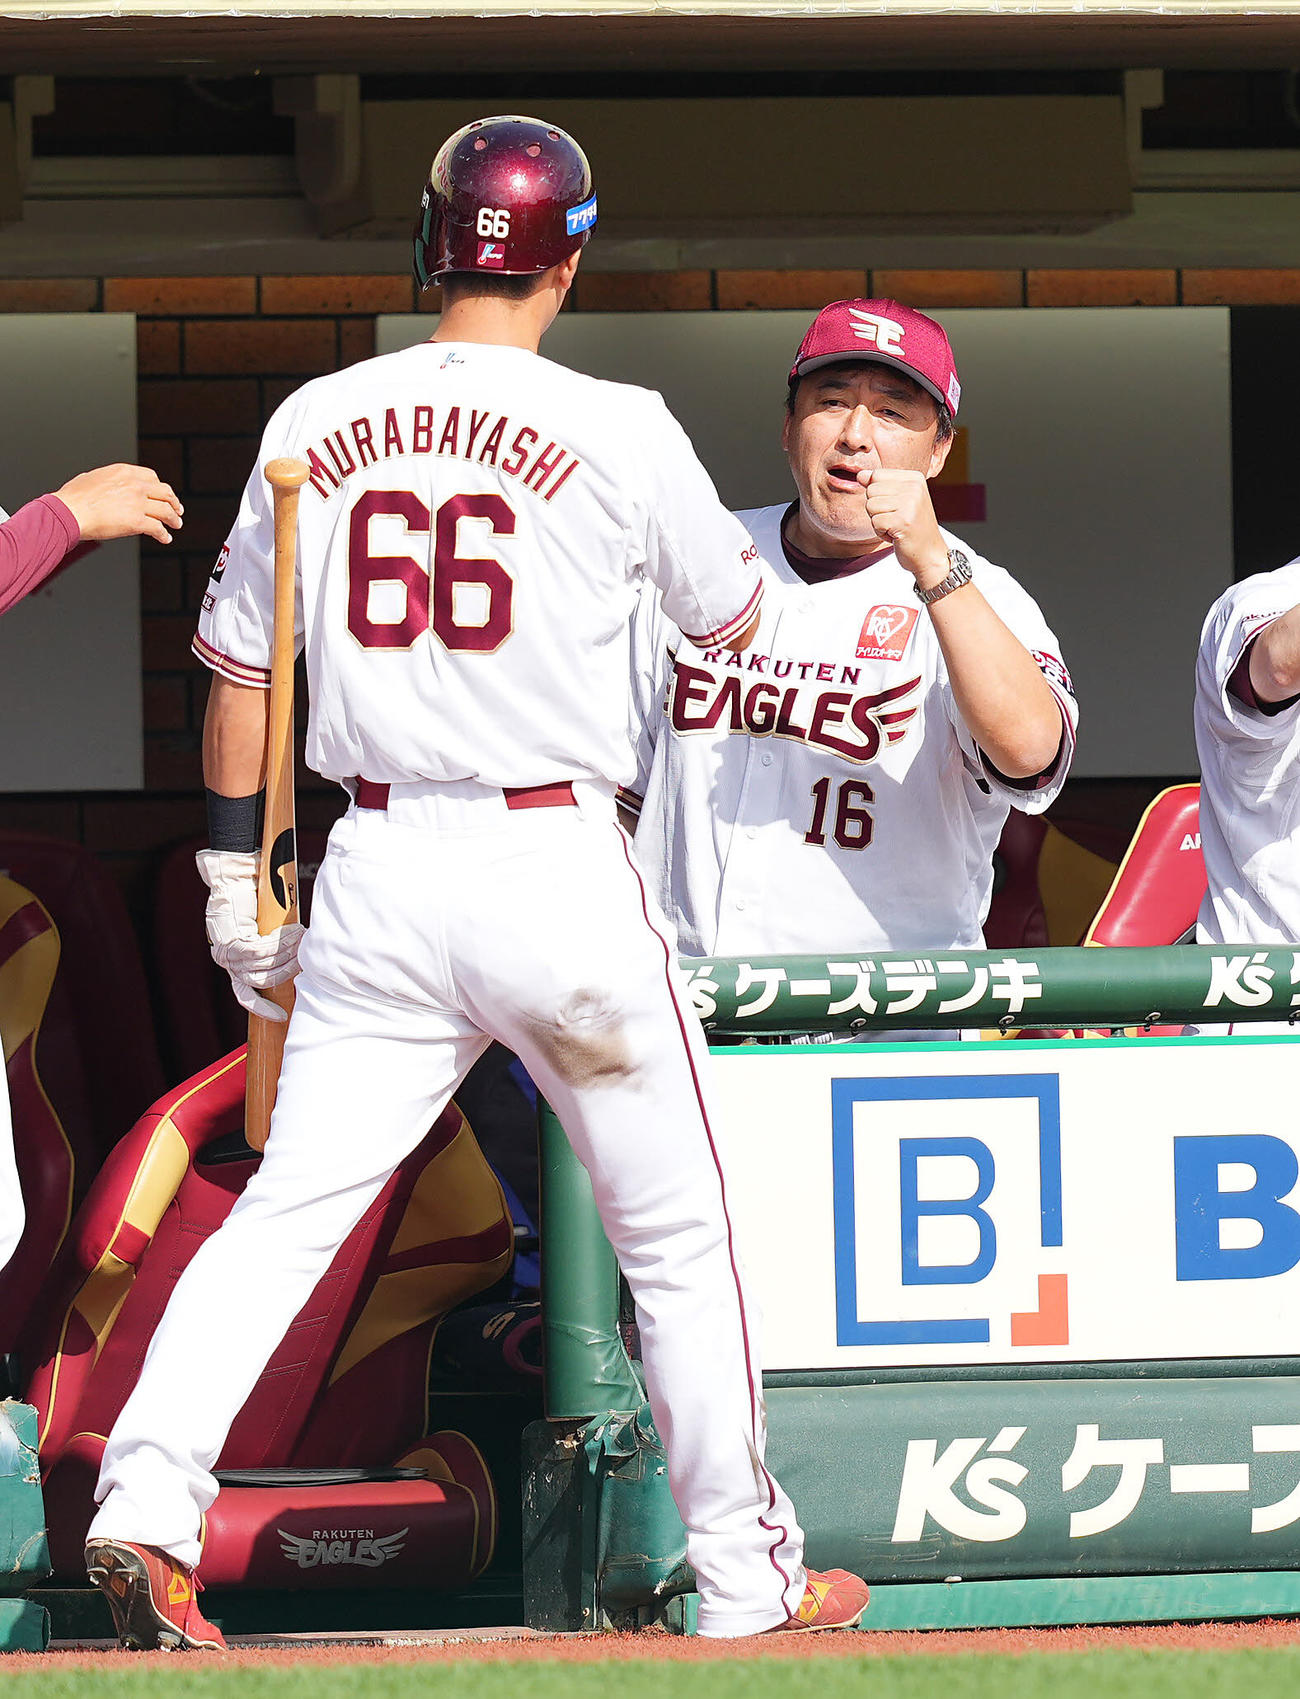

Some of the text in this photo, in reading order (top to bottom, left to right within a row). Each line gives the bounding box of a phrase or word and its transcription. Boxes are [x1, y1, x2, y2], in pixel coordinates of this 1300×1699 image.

[477, 208, 511, 238] 66
[305, 405, 580, 502] MURABAYASHI
[347, 490, 517, 654] 66
[702, 648, 862, 686] RAKUTEN
[668, 660, 922, 765] EAGLES
[803, 776, 875, 851] 16
[735, 959, 1042, 1017] ケーズデンキ
[899, 1136, 997, 1286] B
[1174, 1133, 1300, 1281] B
[290, 1538, 396, 1568] EAGLES
[312, 1529, 374, 1539] RAKUTEN
